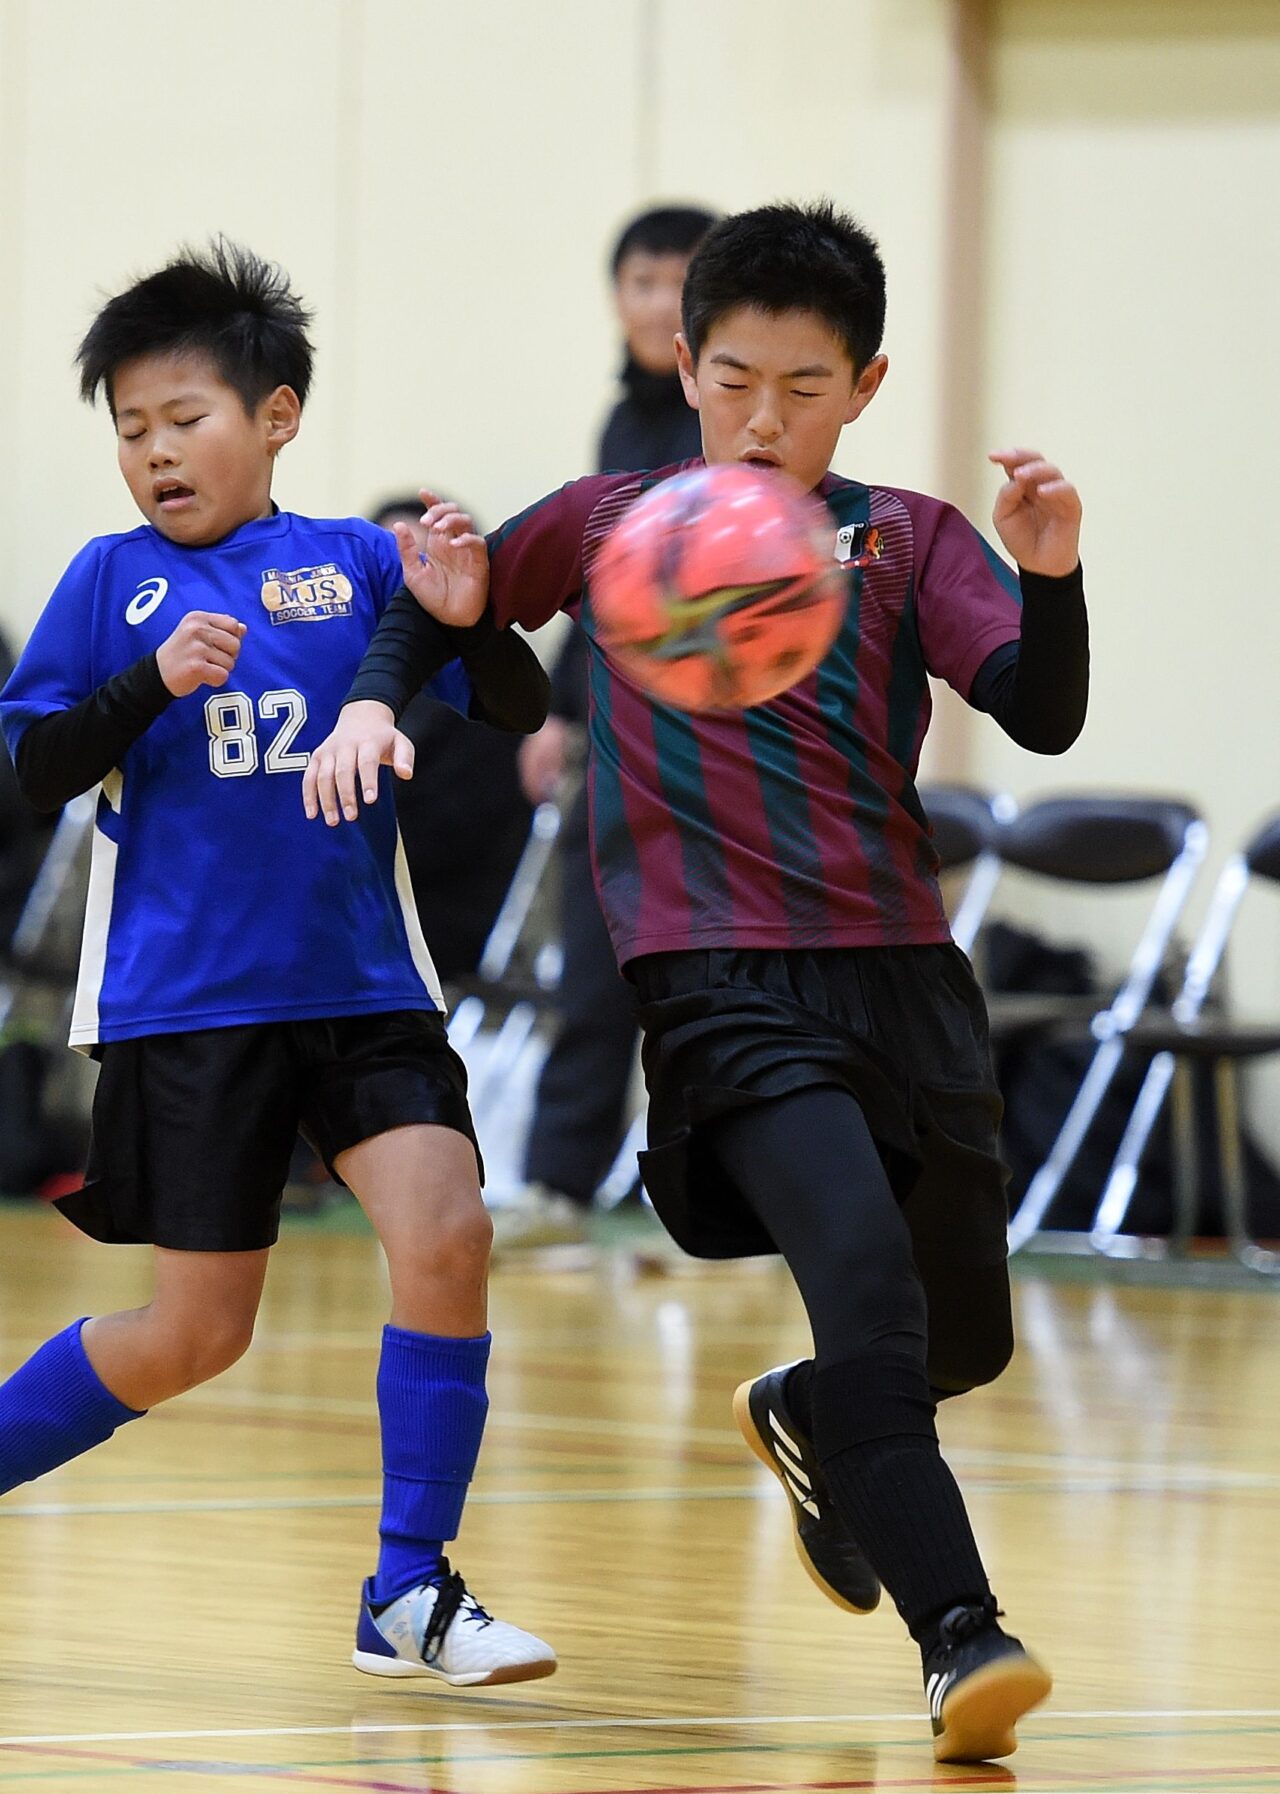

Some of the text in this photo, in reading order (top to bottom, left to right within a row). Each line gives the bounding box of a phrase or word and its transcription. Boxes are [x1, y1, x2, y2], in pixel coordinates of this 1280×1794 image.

[278, 580, 337, 604] MJS
[276, 603, 348, 621] SOCCER TEAM
[204, 689, 310, 778] 82
